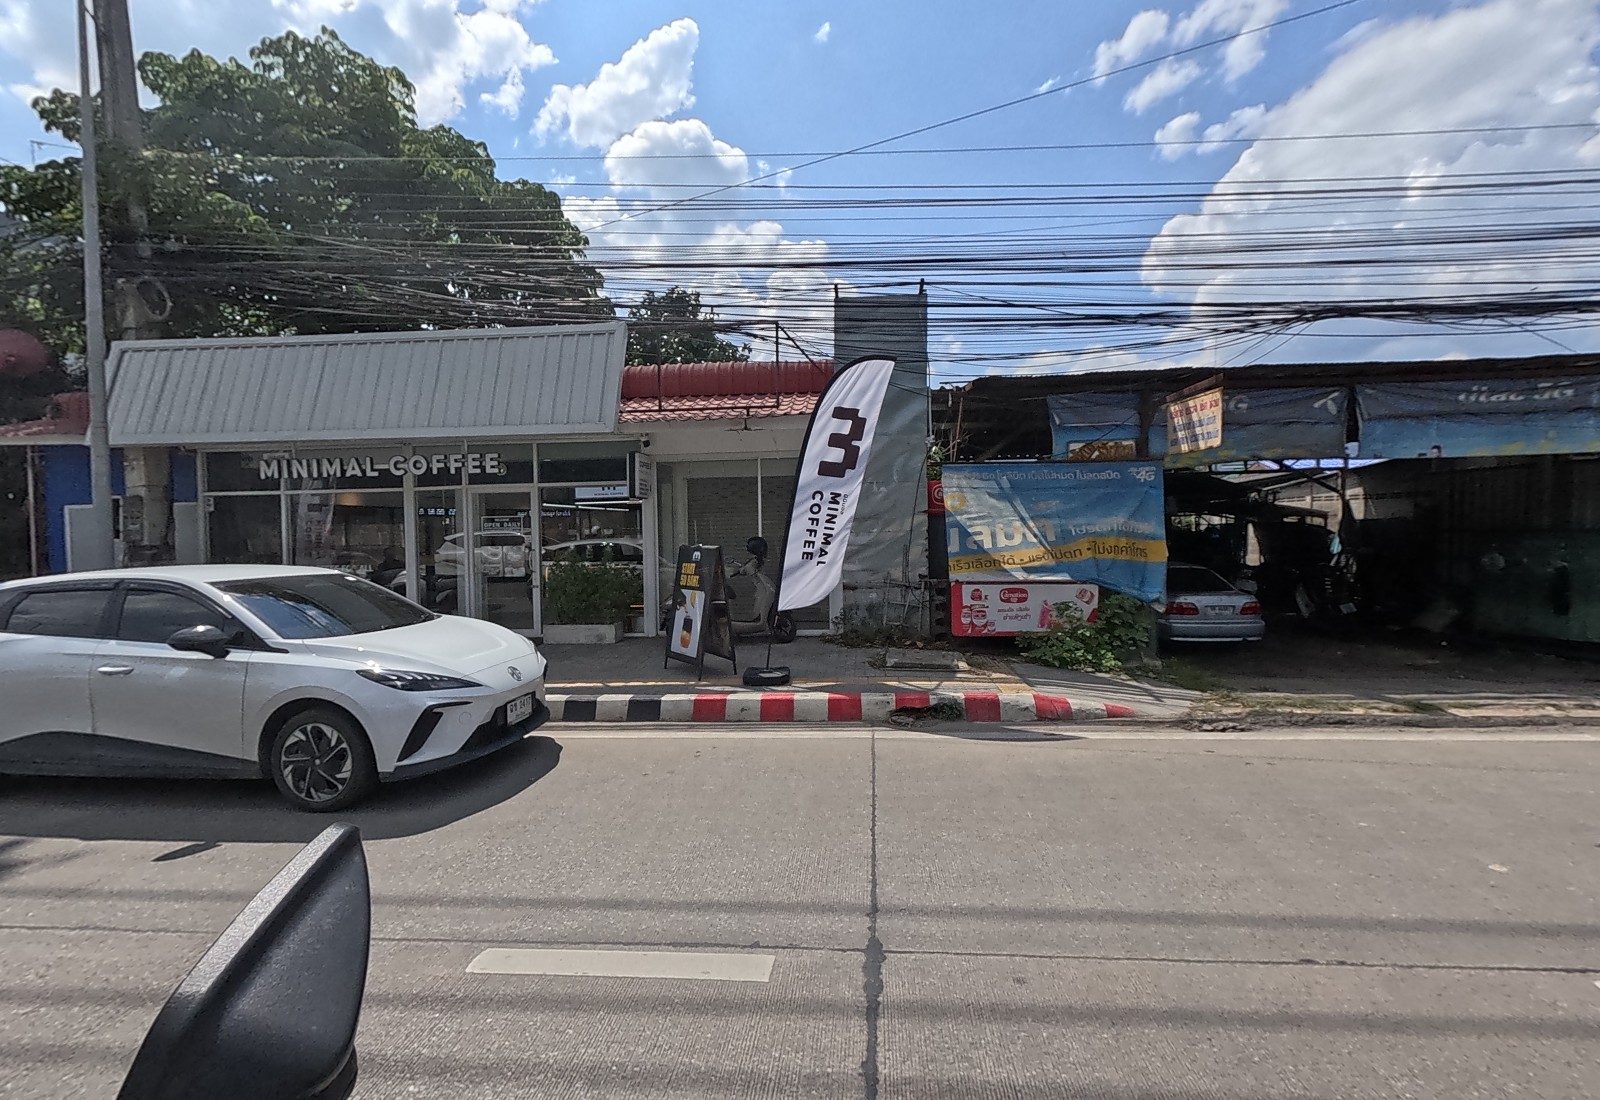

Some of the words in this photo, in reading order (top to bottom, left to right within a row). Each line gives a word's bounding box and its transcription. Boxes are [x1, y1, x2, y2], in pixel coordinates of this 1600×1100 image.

[259, 455, 379, 481] MINIMAL
[388, 452, 501, 477] COFFEE
[801, 490, 824, 561] COFFEE
[816, 491, 842, 567] MINIMAL
